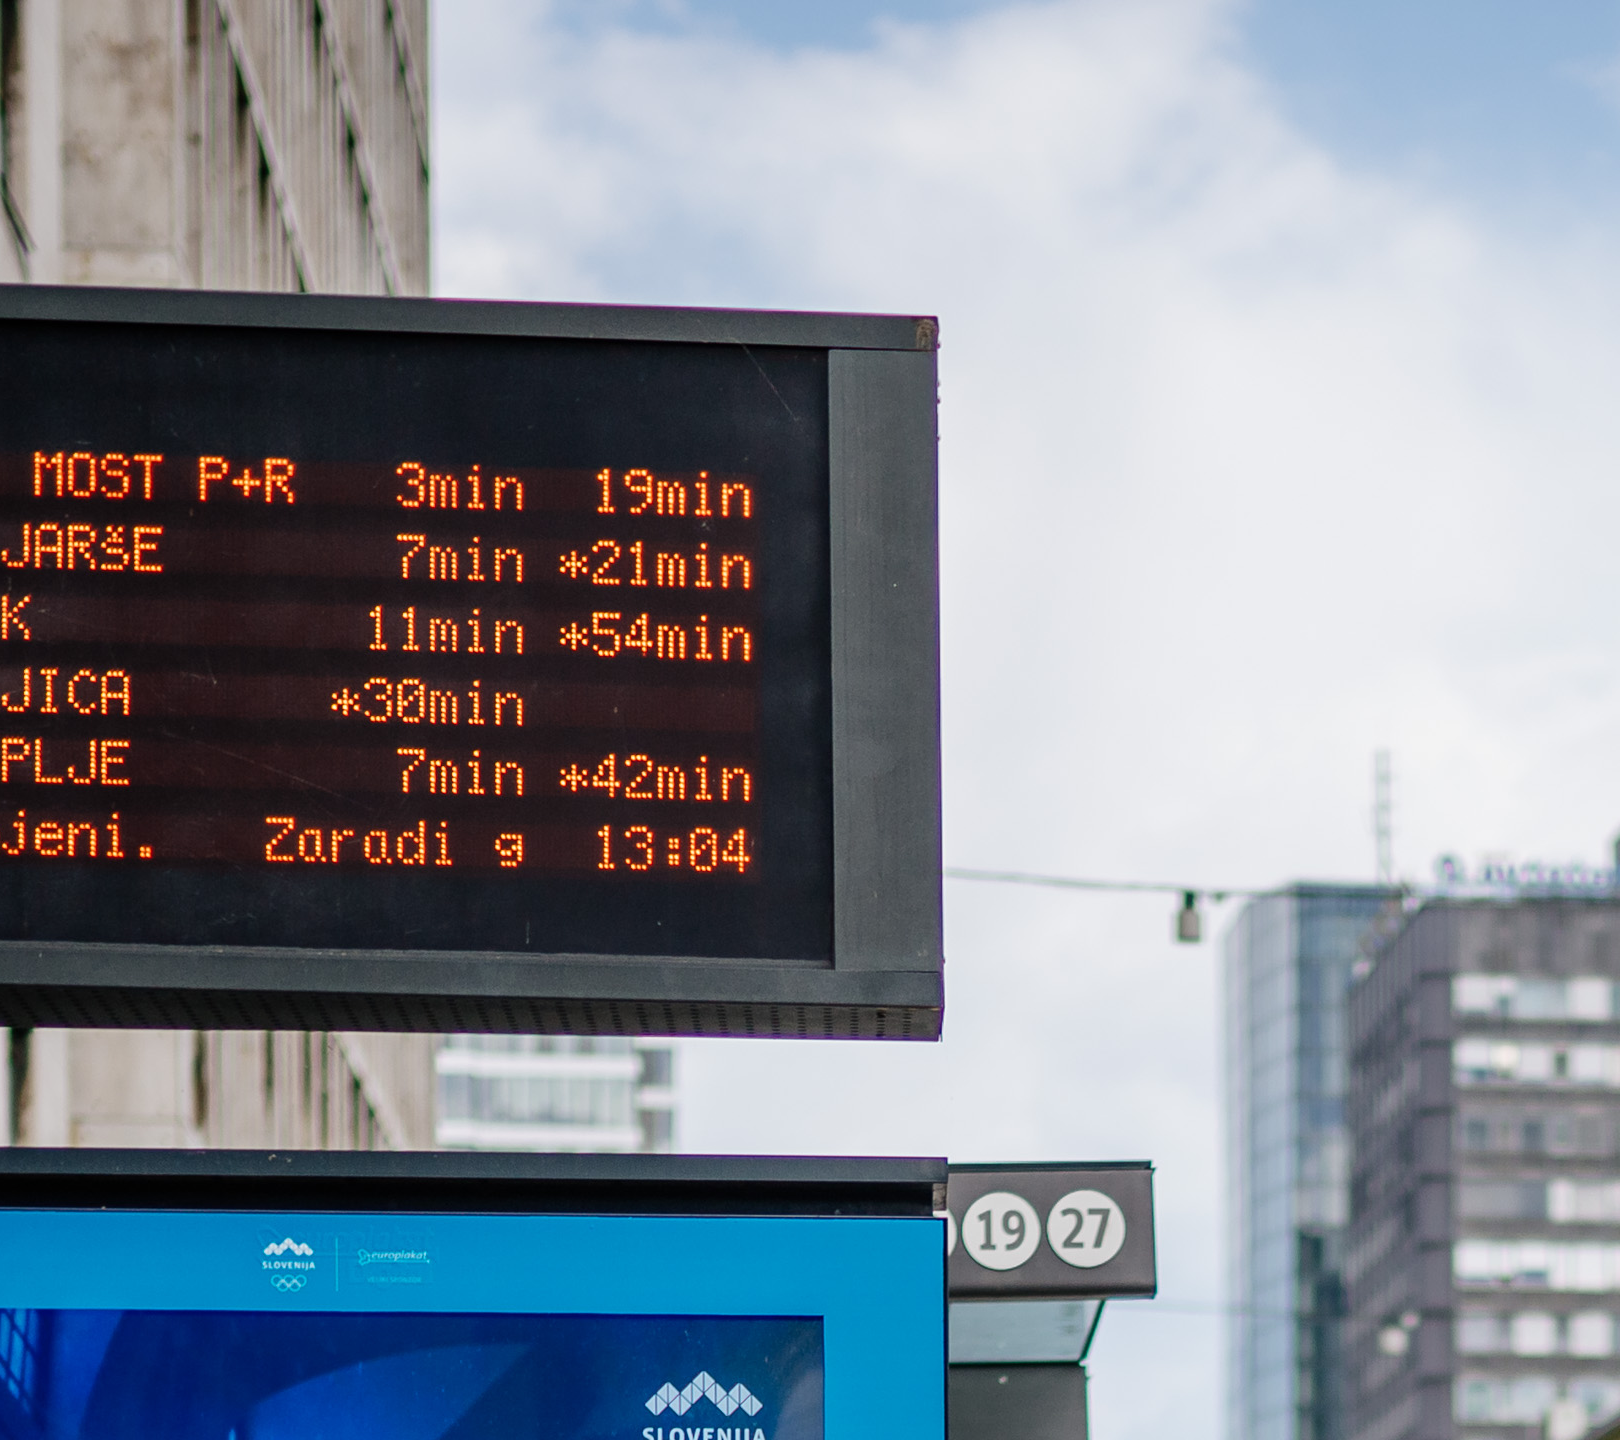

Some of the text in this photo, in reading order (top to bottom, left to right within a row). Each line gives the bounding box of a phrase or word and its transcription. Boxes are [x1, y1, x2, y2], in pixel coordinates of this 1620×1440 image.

[32, 450, 164, 500] MOST
[198, 455, 296, 505] P+R
[395, 461, 525, 512] 3min
[595, 467, 753, 519] 19min
[0, 519, 164, 573] JARŠE
[396, 532, 525, 584] 7min
[368, 604, 525, 655] 11min
[396, 747, 525, 797] 7min
[264, 815, 453, 867] Zaradi
[494, 832, 525, 868] g
[597, 824, 752, 874] 13:04
[977, 1207, 1111, 1251] 19 27
[262, 1261, 316, 1271] SLOVENIJA
